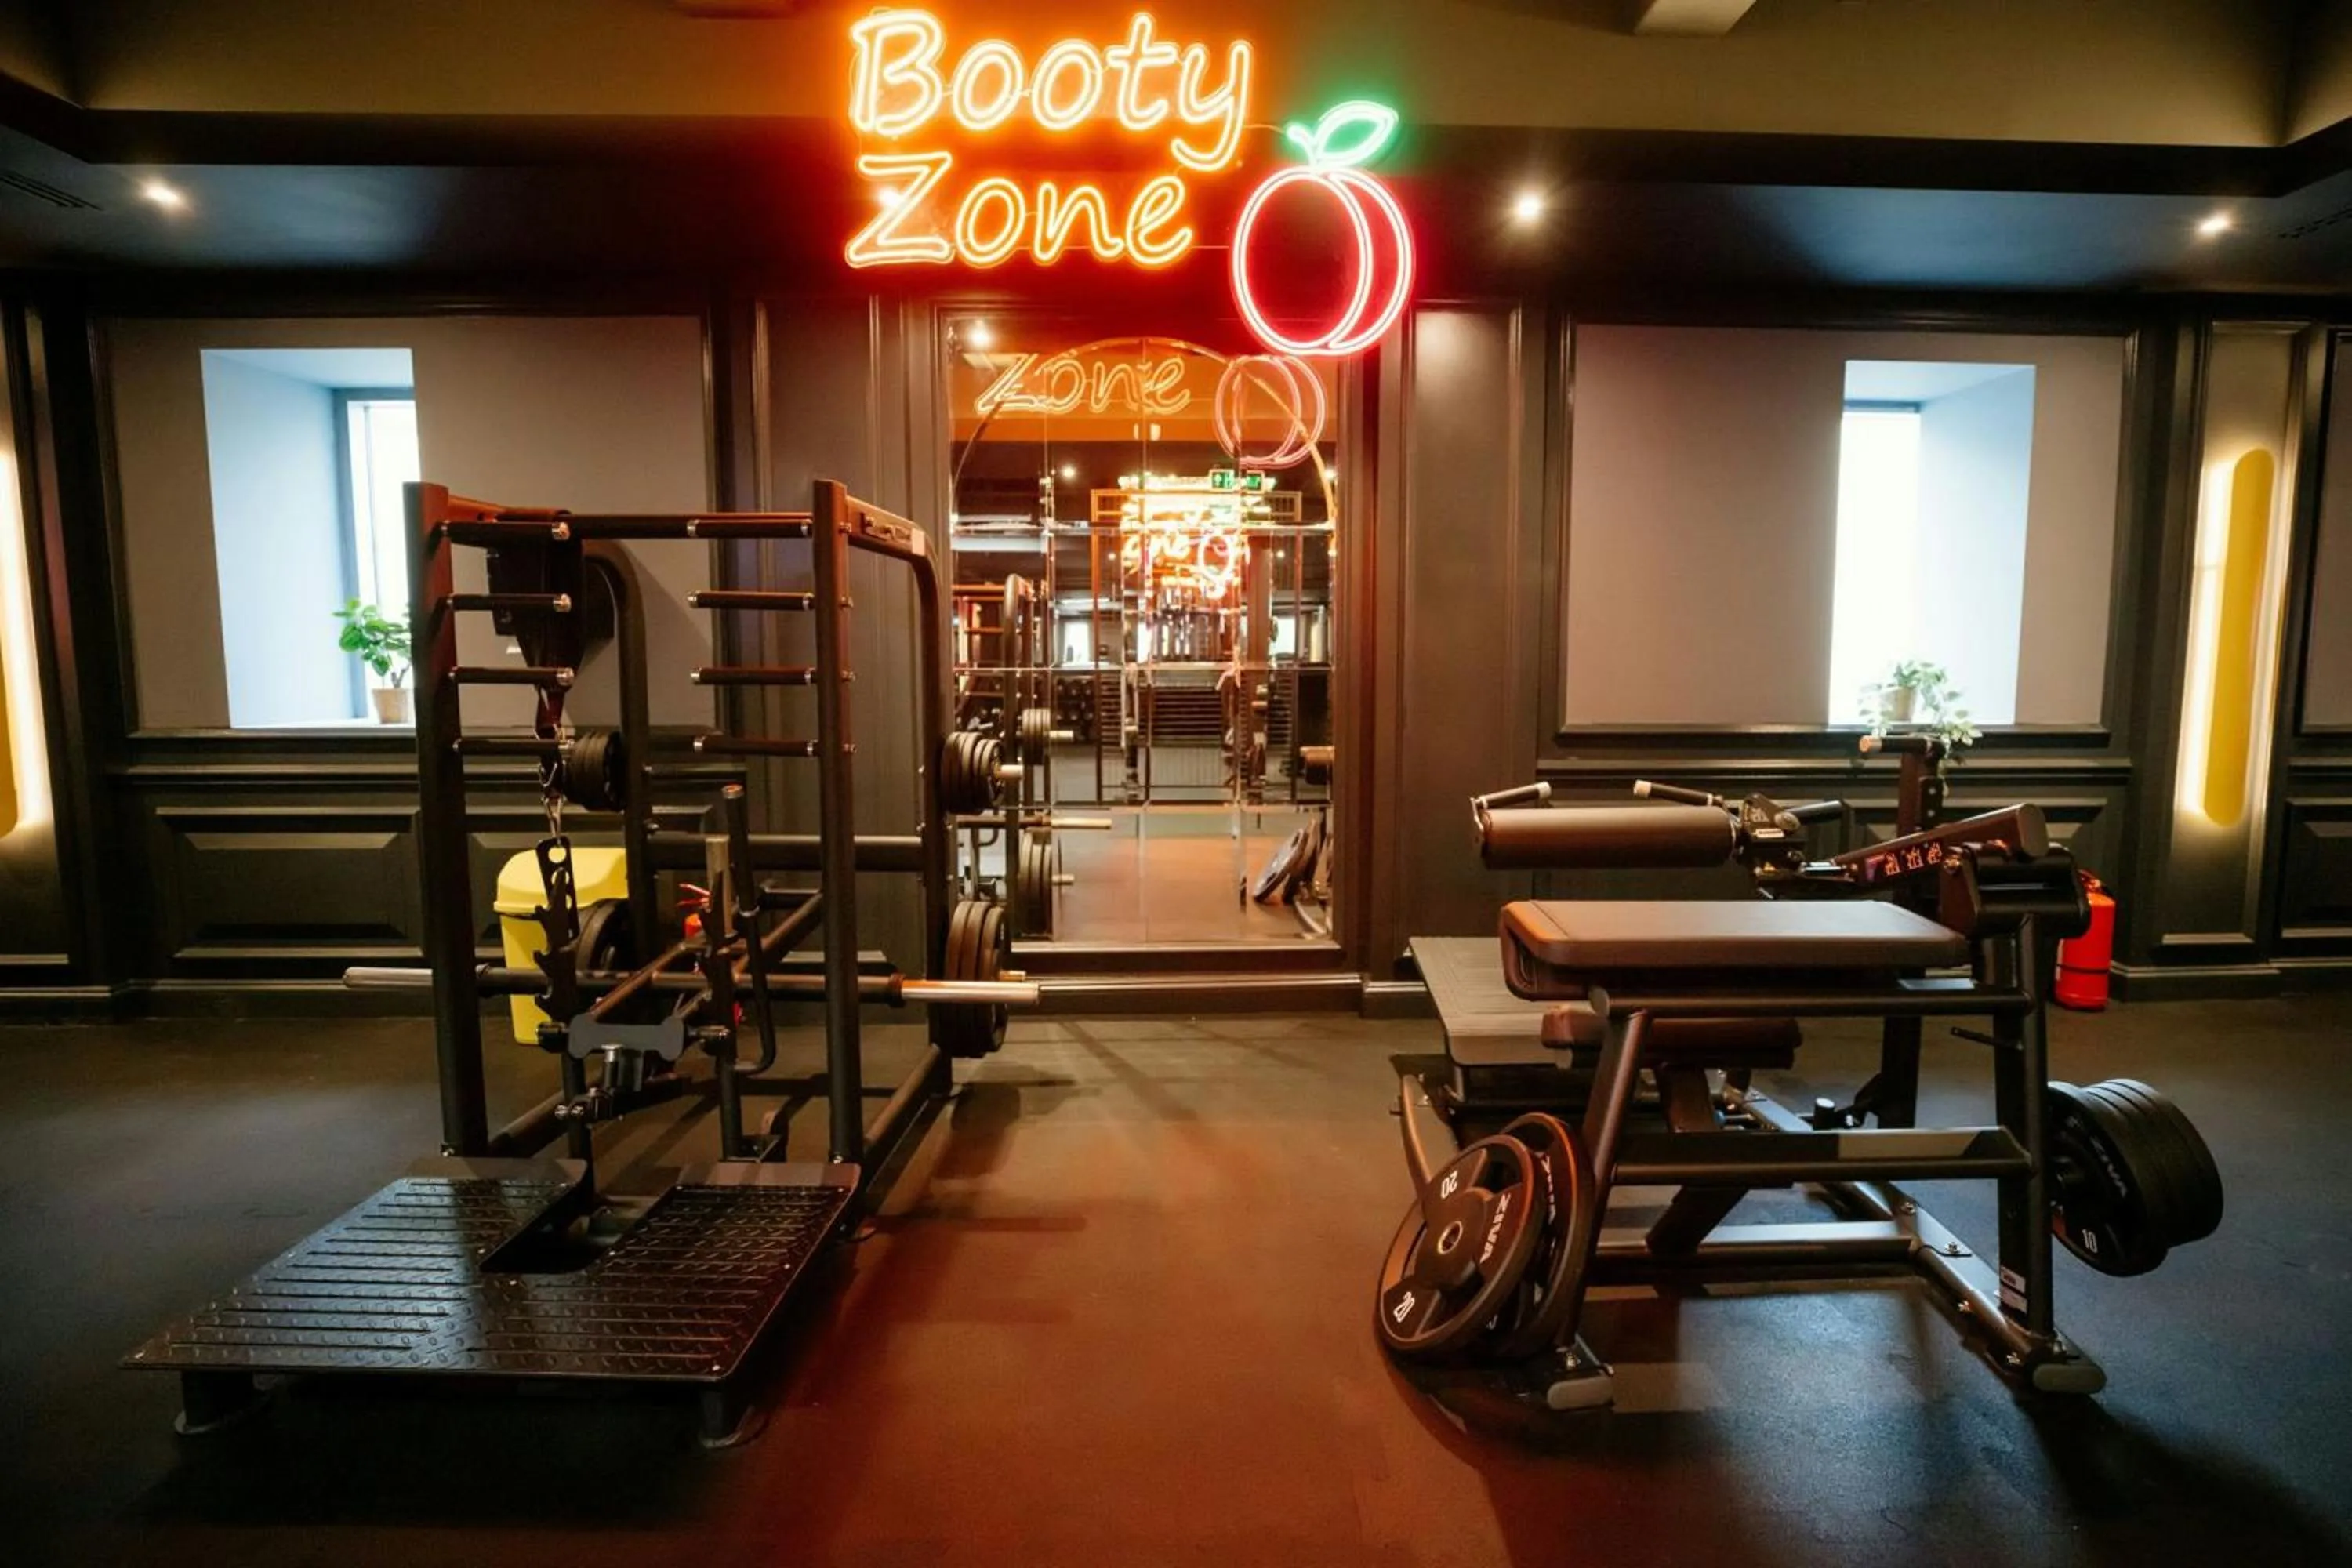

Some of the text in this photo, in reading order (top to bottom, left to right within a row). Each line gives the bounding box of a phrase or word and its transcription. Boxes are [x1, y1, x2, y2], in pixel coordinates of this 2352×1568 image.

[849, 9, 1252, 172] Booty
[846, 151, 1194, 267] Zone
[963, 353, 1191, 415] Zone
[1440, 1170, 1459, 1200] 20
[1479, 1192, 1512, 1265] ZIVA
[2082, 1229, 2099, 1254] 10
